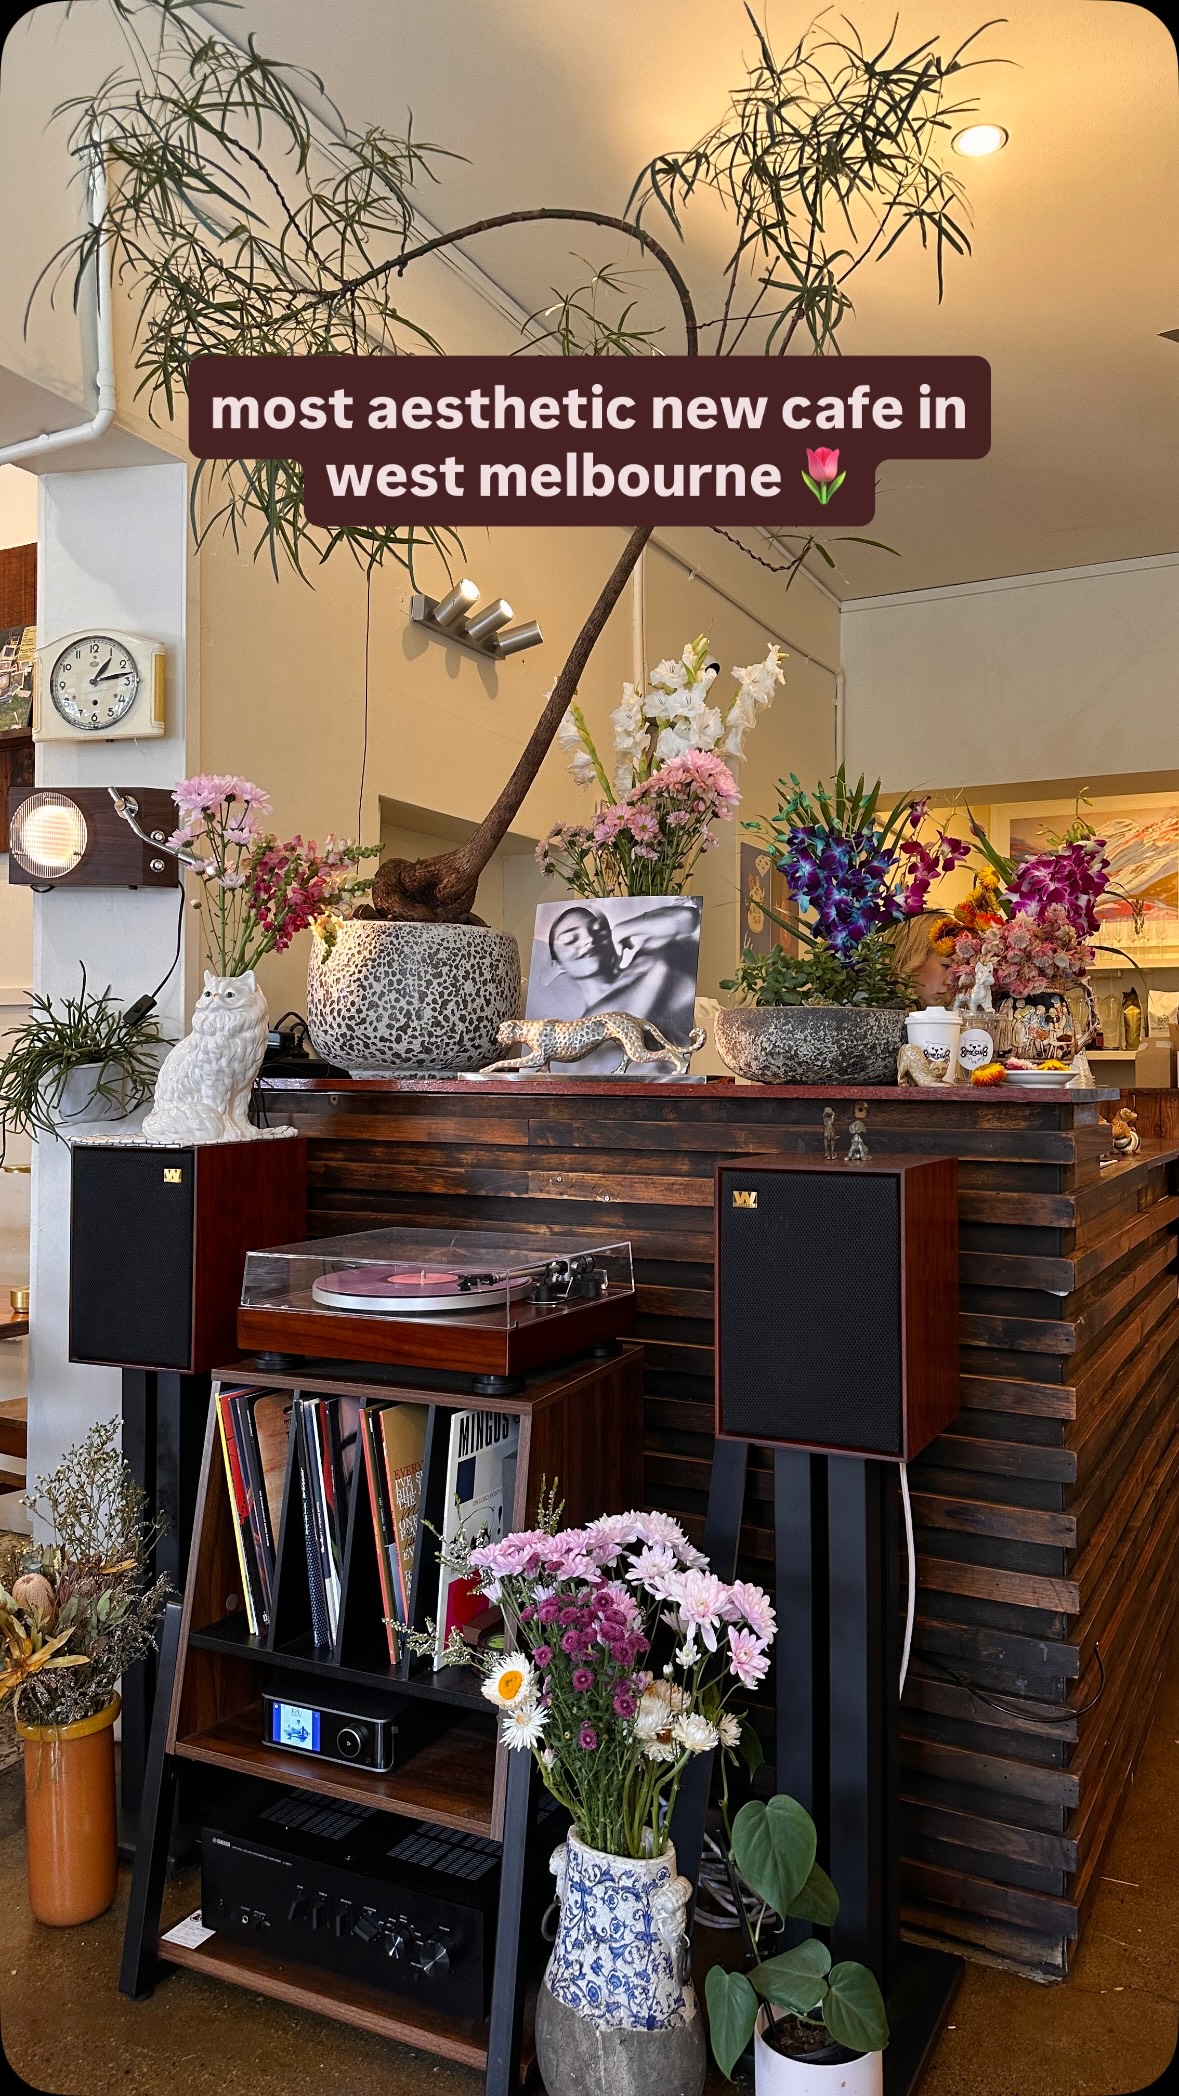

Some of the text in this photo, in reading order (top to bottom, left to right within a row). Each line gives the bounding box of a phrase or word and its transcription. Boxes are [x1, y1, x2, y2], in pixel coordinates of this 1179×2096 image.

[89, 643, 99, 653] 12
[109, 647, 113, 657] 1
[75, 649, 81, 659] 11
[62, 663, 72, 672] 10
[119, 659, 127, 669] 2
[59, 681, 66, 690] 9
[124, 676, 131, 686] 3
[118, 694, 126, 703] 4
[77, 709, 83, 718] 7
[91, 712, 98, 722] 6
[107, 707, 114, 717] 5
[458, 1411, 510, 1458] MINGUS
[394, 1460, 424, 1480] EVERY
[396, 1485, 416, 1500] BILL
